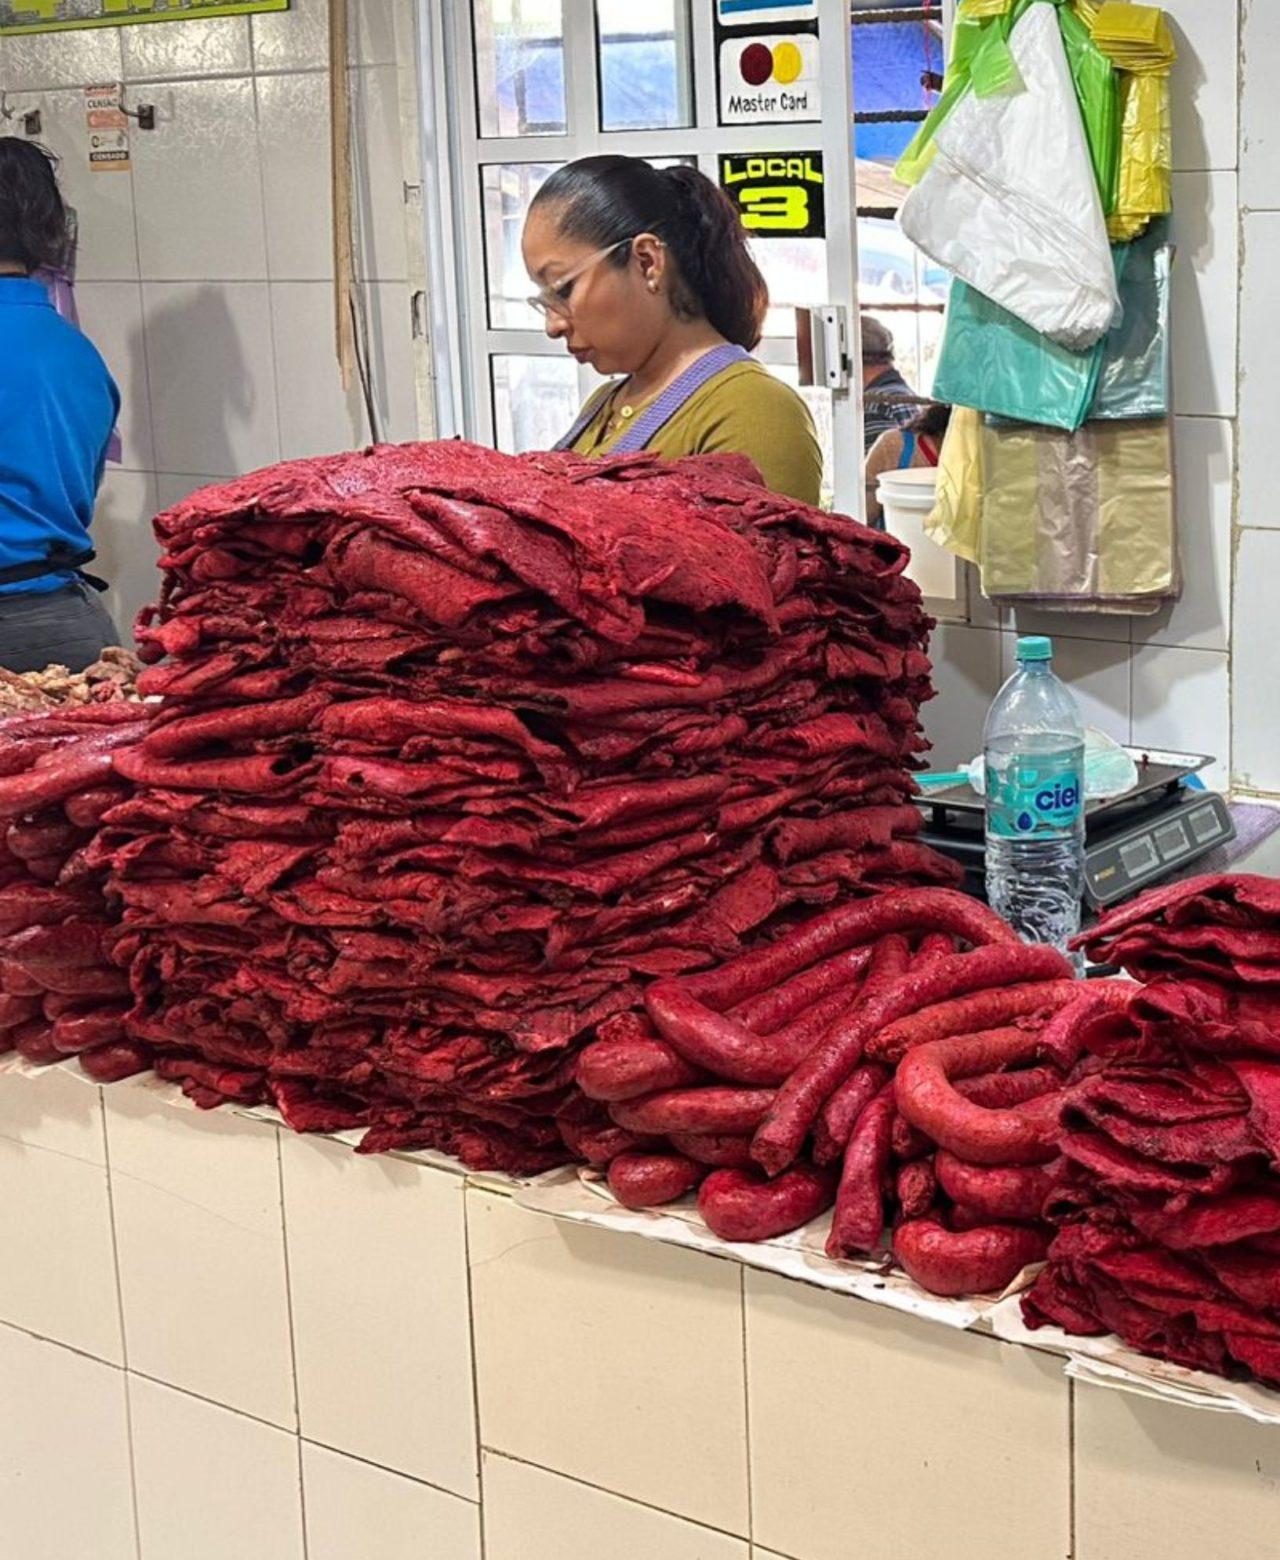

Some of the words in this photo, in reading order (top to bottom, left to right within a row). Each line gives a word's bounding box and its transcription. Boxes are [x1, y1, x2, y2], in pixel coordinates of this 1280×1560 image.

[728, 92, 777, 113] Master
[780, 91, 807, 110] Card
[724, 158, 824, 184] LOCAL
[739, 186, 809, 229] 3
[1035, 779, 1079, 811] ciel
